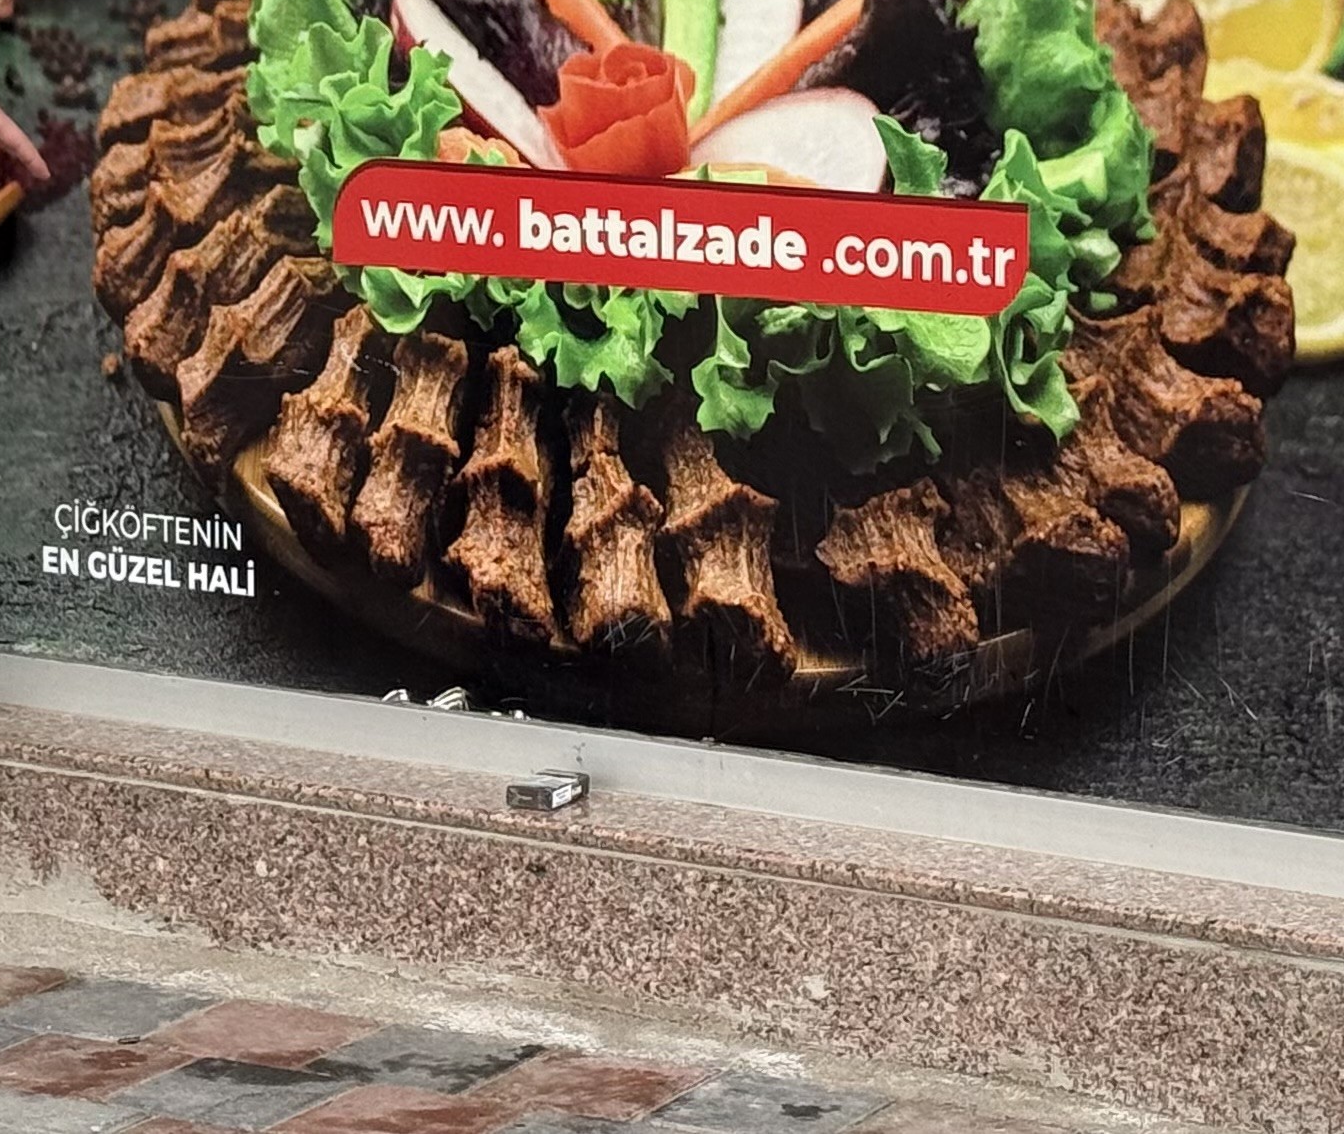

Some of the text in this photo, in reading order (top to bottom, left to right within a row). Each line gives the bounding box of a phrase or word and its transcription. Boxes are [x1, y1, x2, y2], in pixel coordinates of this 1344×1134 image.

[519, 198, 806, 269] battalzade
[822, 231, 1015, 288] .com.tr
[55, 499, 243, 551] ÇİĞKÖFTENİN
[42, 545, 256, 596] EN GÜZEL HALİ
